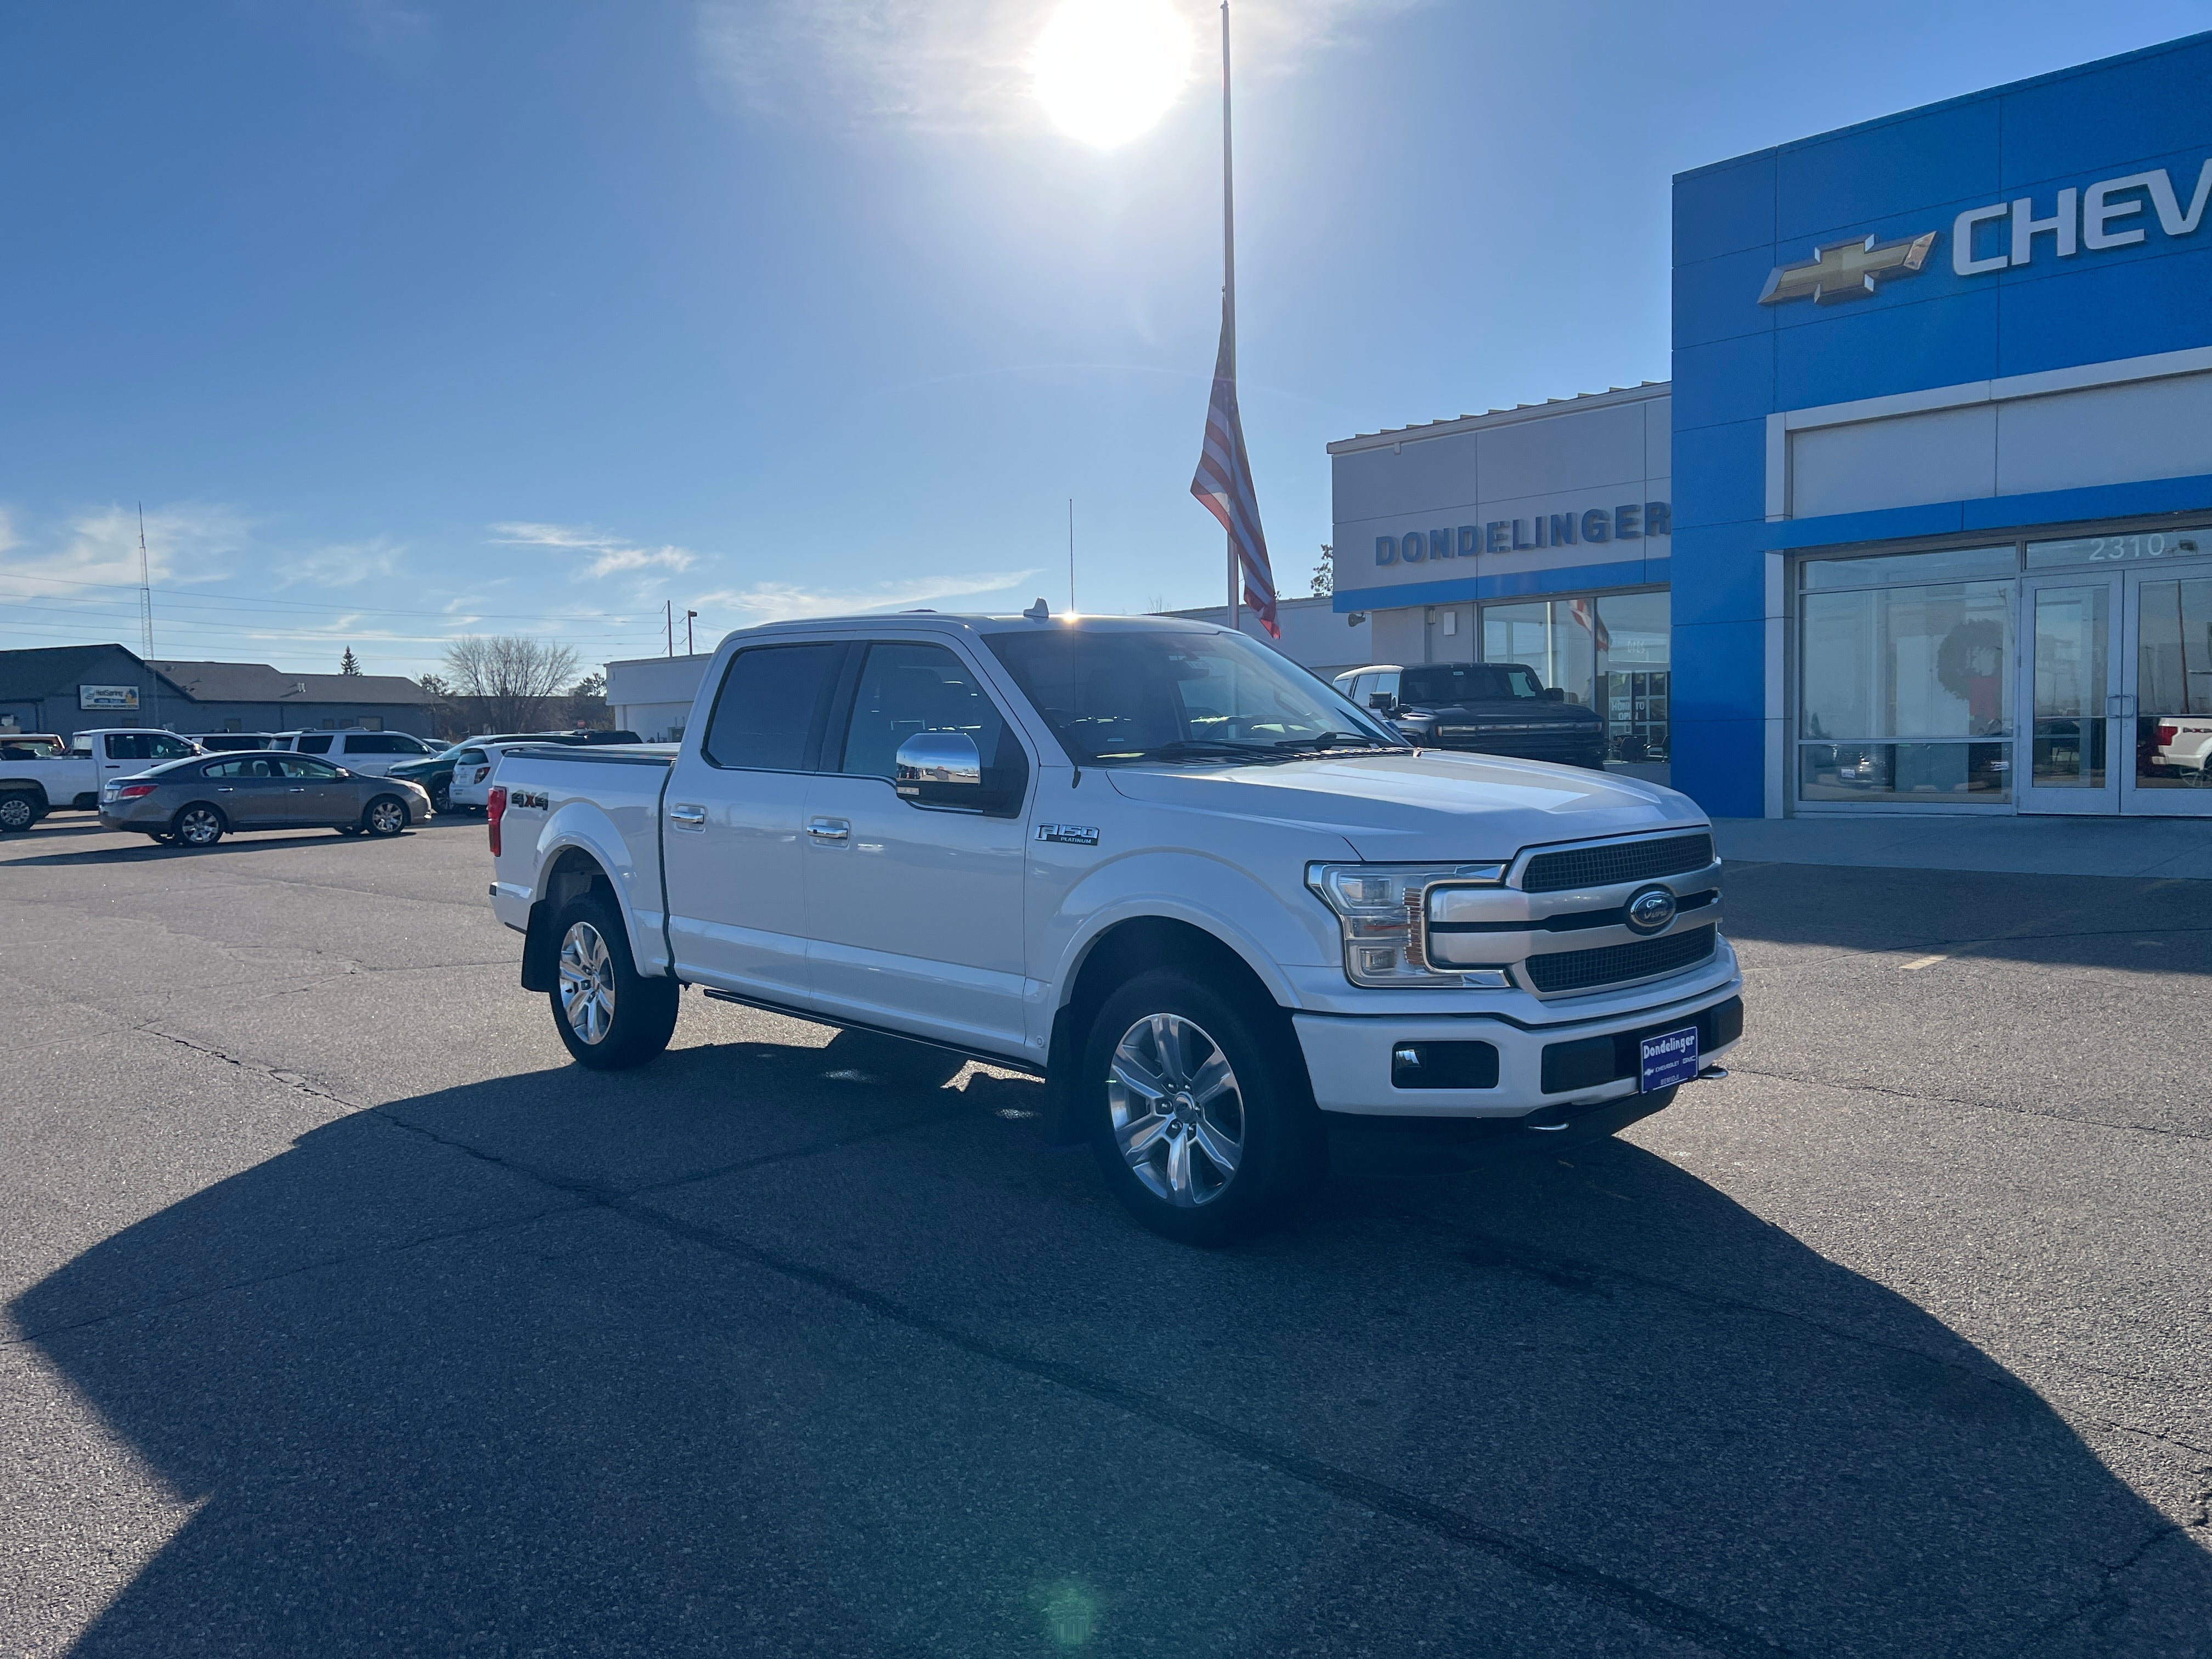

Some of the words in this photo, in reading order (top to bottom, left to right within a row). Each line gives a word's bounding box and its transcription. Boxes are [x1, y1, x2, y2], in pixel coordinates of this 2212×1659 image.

[1953, 158, 2212, 275] CHEV
[1376, 501, 1671, 566] DONDELINGER
[2089, 533, 2165, 561] 2310
[1644, 1036, 1695, 1059] Dondelinger
